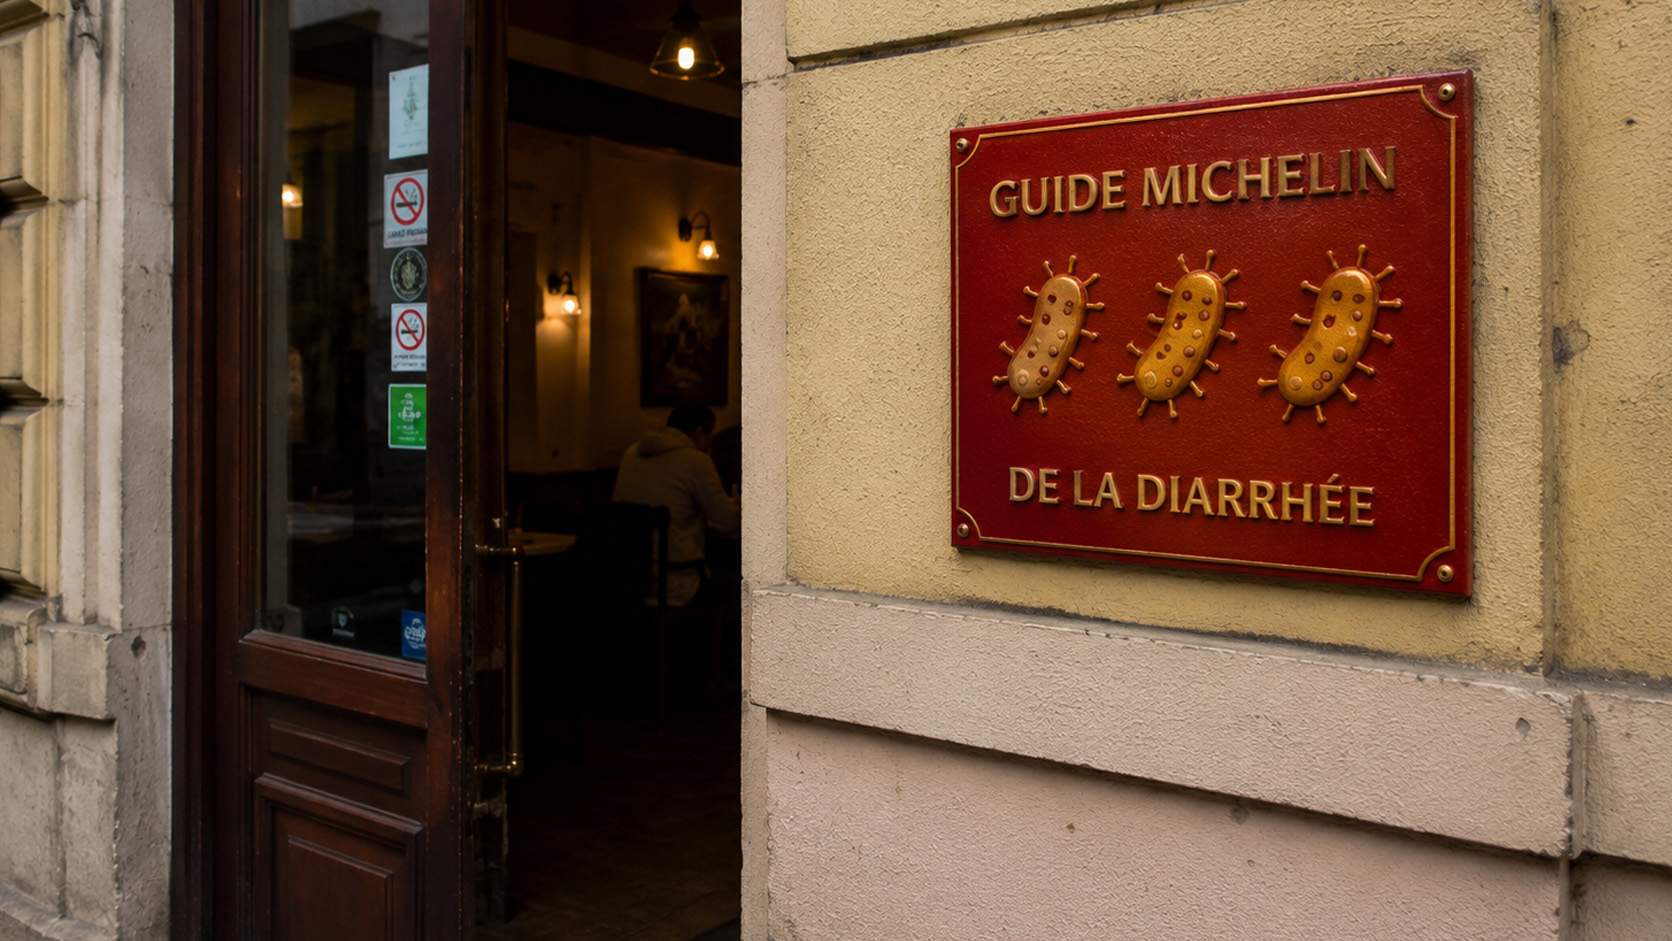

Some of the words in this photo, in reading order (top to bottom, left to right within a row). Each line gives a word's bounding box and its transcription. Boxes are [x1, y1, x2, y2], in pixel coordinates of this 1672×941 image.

[989, 170, 1126, 218] GUIDE
[1141, 145, 1397, 206] MICHELIN
[1009, 466, 1060, 504] DE
[1072, 469, 1123, 509] LA
[1136, 473, 1376, 527] DIARRHÉE
